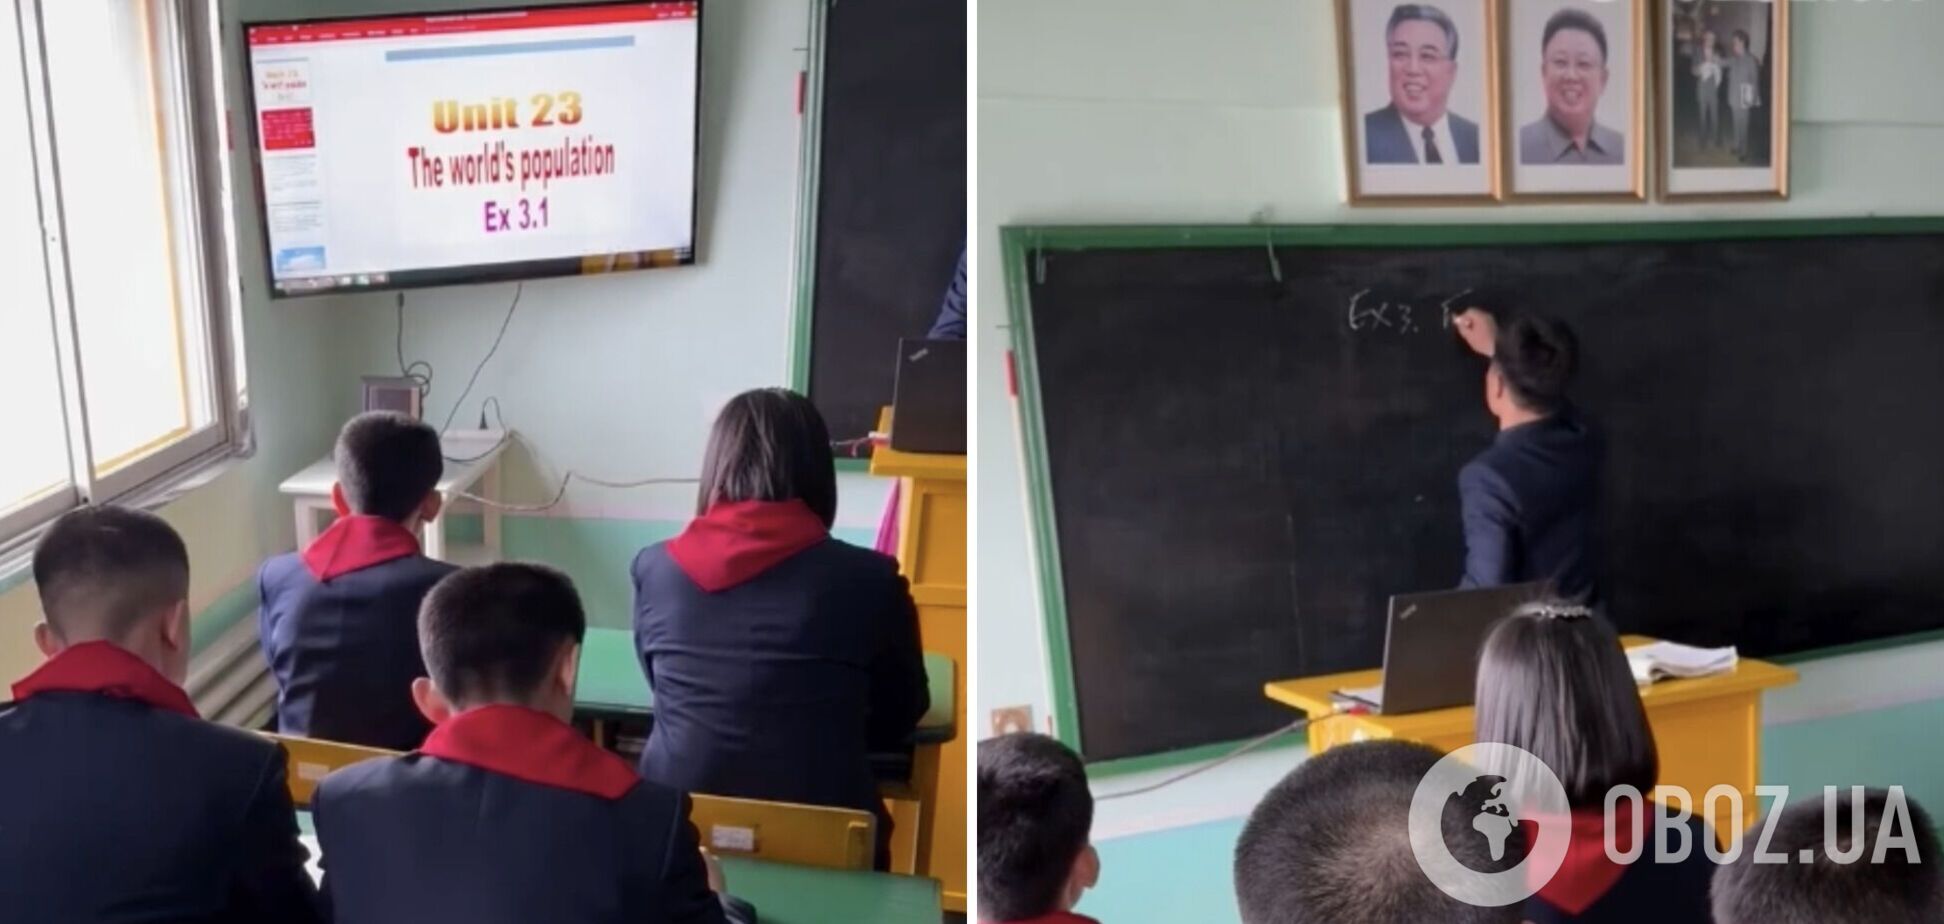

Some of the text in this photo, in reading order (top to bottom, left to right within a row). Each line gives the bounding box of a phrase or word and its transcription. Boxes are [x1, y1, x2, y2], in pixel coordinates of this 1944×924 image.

[433, 90, 583, 134] Unit 23
[408, 135, 616, 191] The world's population
[484, 196, 549, 233] Ex 3.1
